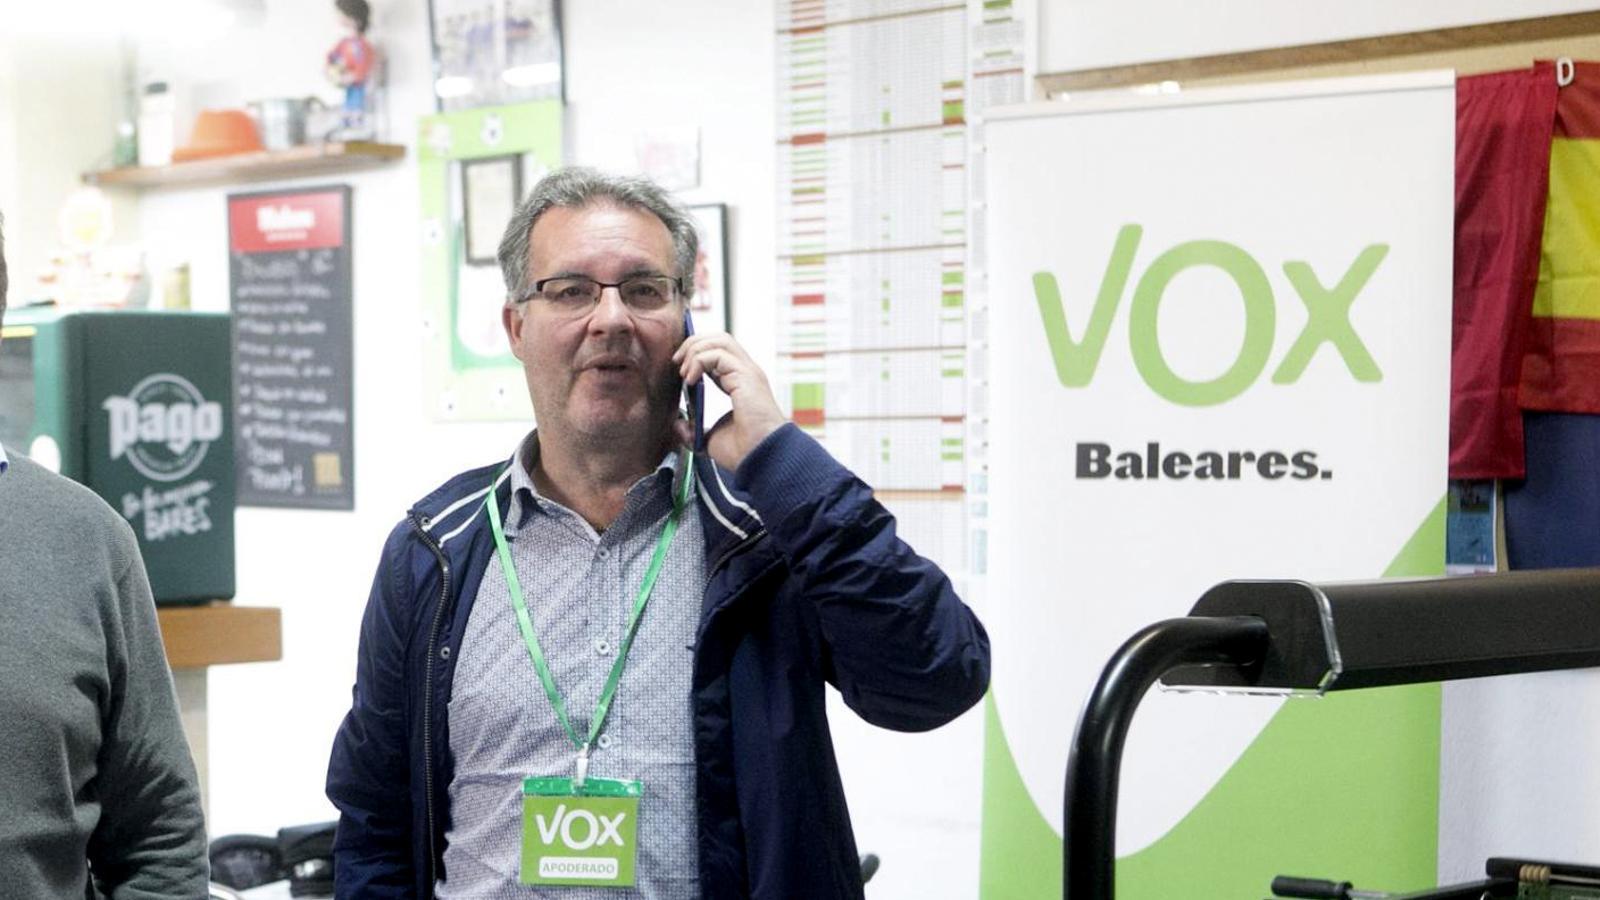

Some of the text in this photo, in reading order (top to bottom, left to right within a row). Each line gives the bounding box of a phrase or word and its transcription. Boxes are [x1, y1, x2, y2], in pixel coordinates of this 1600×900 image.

[1032, 223, 1390, 408] VOX
[1075, 441, 1333, 480] Baleares.
[535, 804, 626, 851] VOX
[542, 862, 616, 875] APODERADO
